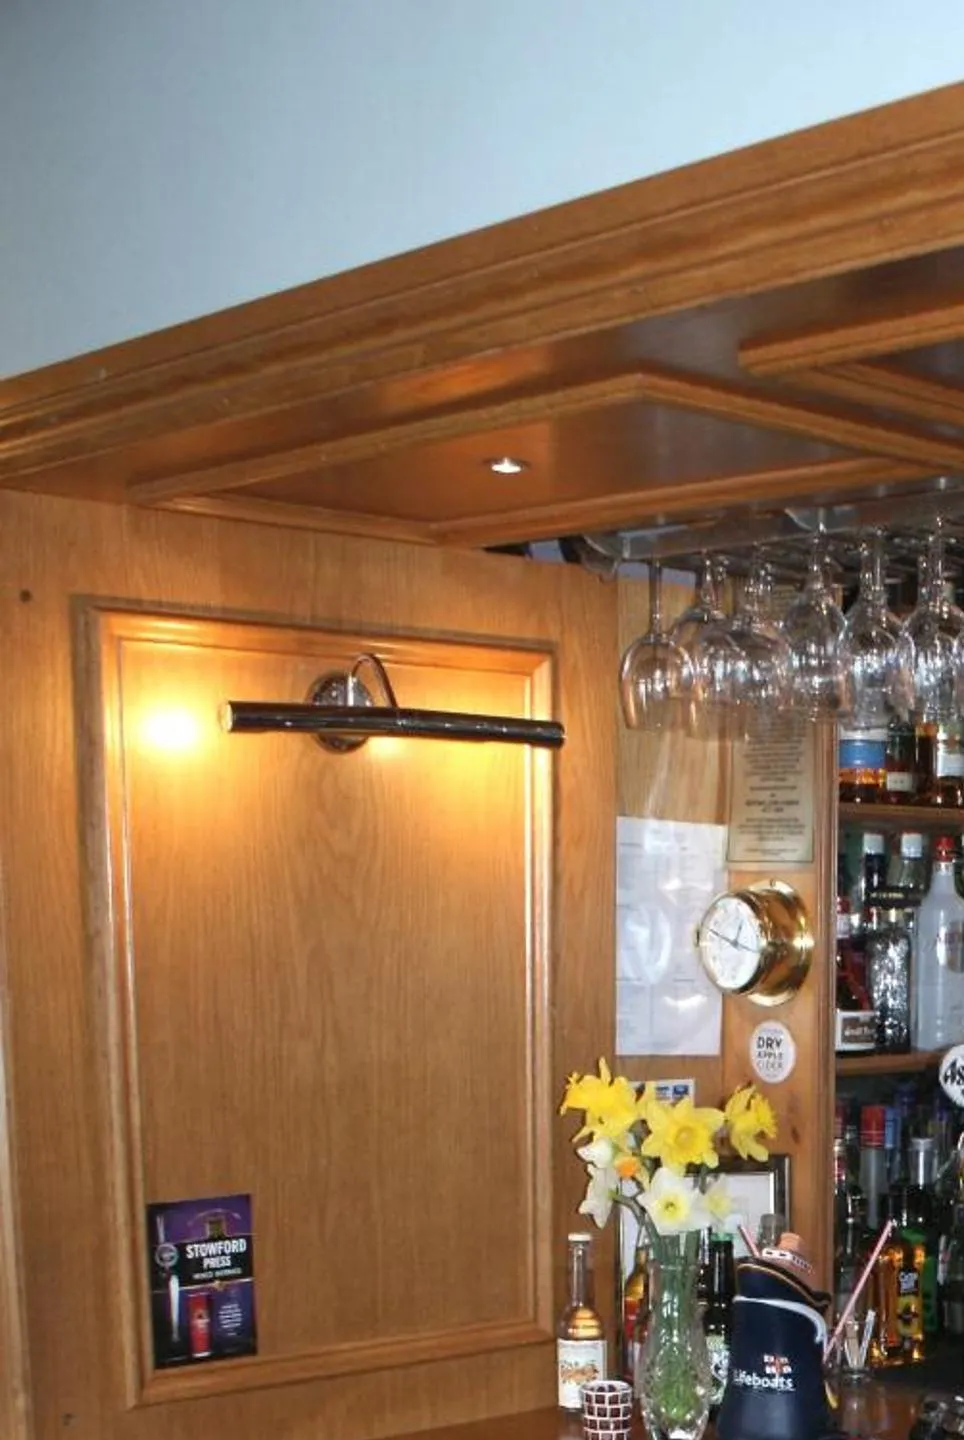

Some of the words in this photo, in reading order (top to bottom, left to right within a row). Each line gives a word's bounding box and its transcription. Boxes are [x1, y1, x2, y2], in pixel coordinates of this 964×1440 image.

[756, 1036, 783, 1049] DRY
[186, 1238, 247, 1259] STOWFORD
[203, 1255, 232, 1269] PRESS
